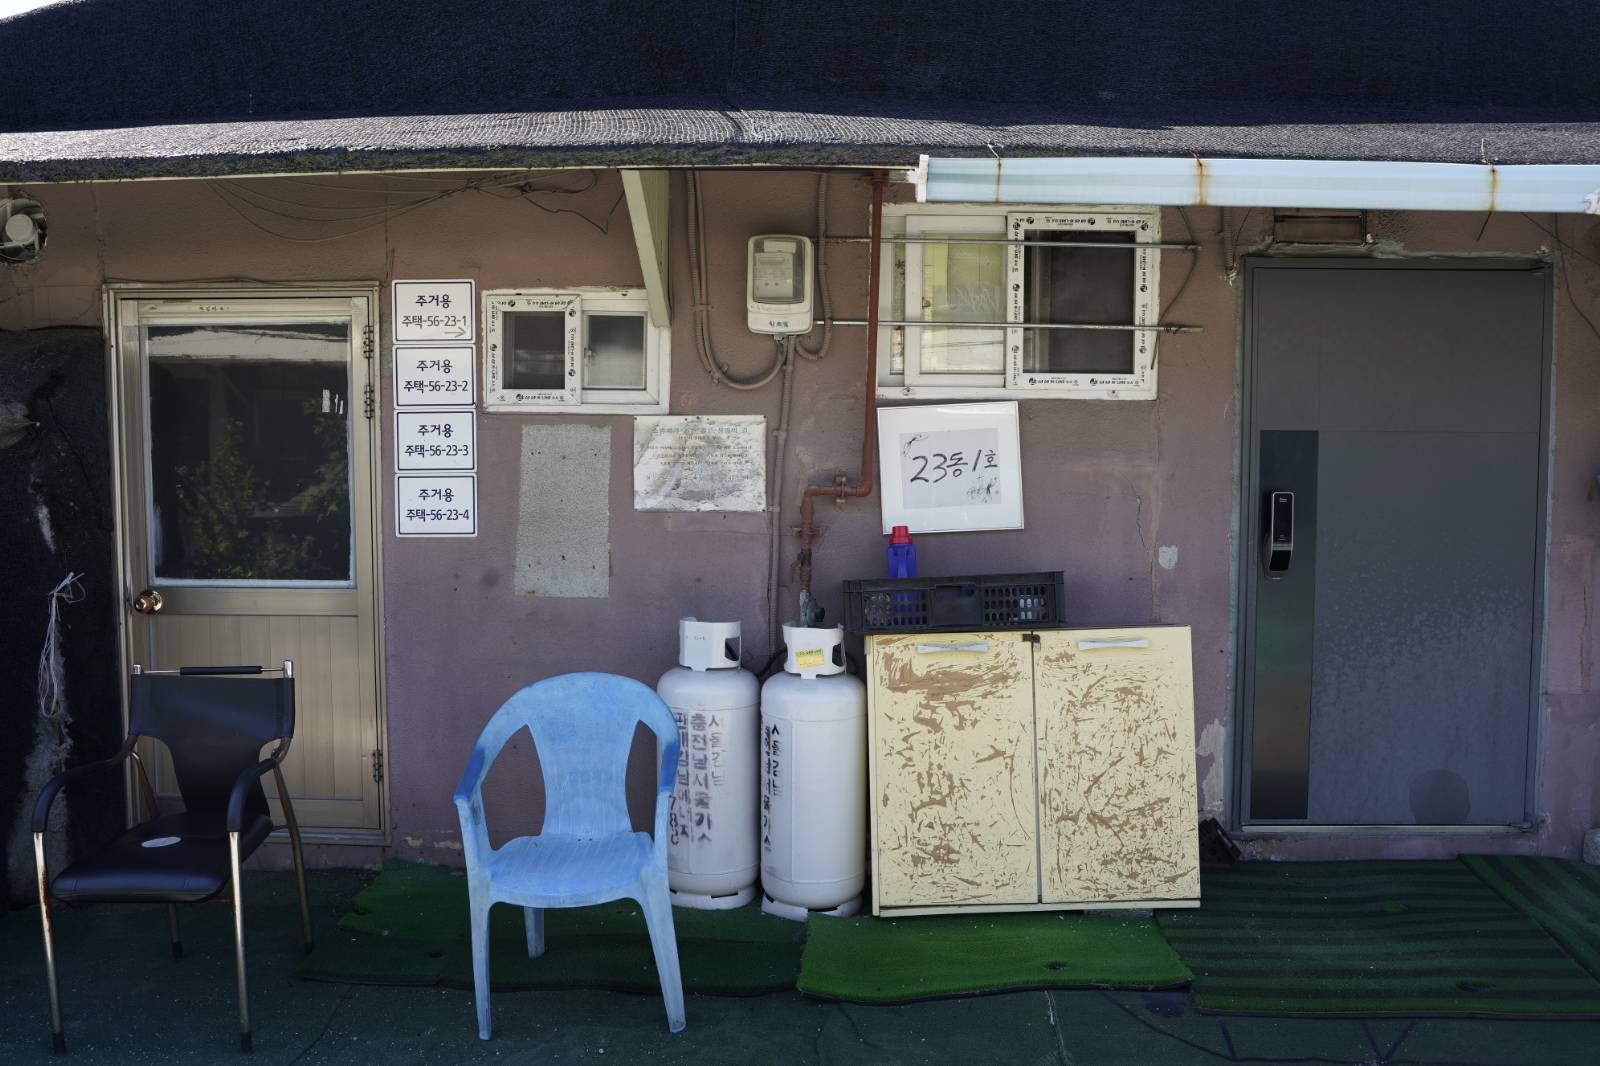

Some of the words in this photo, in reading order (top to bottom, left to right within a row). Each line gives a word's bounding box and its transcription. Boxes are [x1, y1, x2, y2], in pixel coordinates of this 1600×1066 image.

[415, 294, 452, 309] 주거용
[401, 315, 467, 328] 주택-56-23-1
[416, 359, 453, 374] 주거용
[403, 380, 469, 394] 주택-56-23-2
[417, 423, 454, 438] 주거용
[404, 444, 469, 458] 주택-56-23-3
[418, 488, 455, 503] 주거용
[406, 509, 470, 522] 주택-56-23-4
